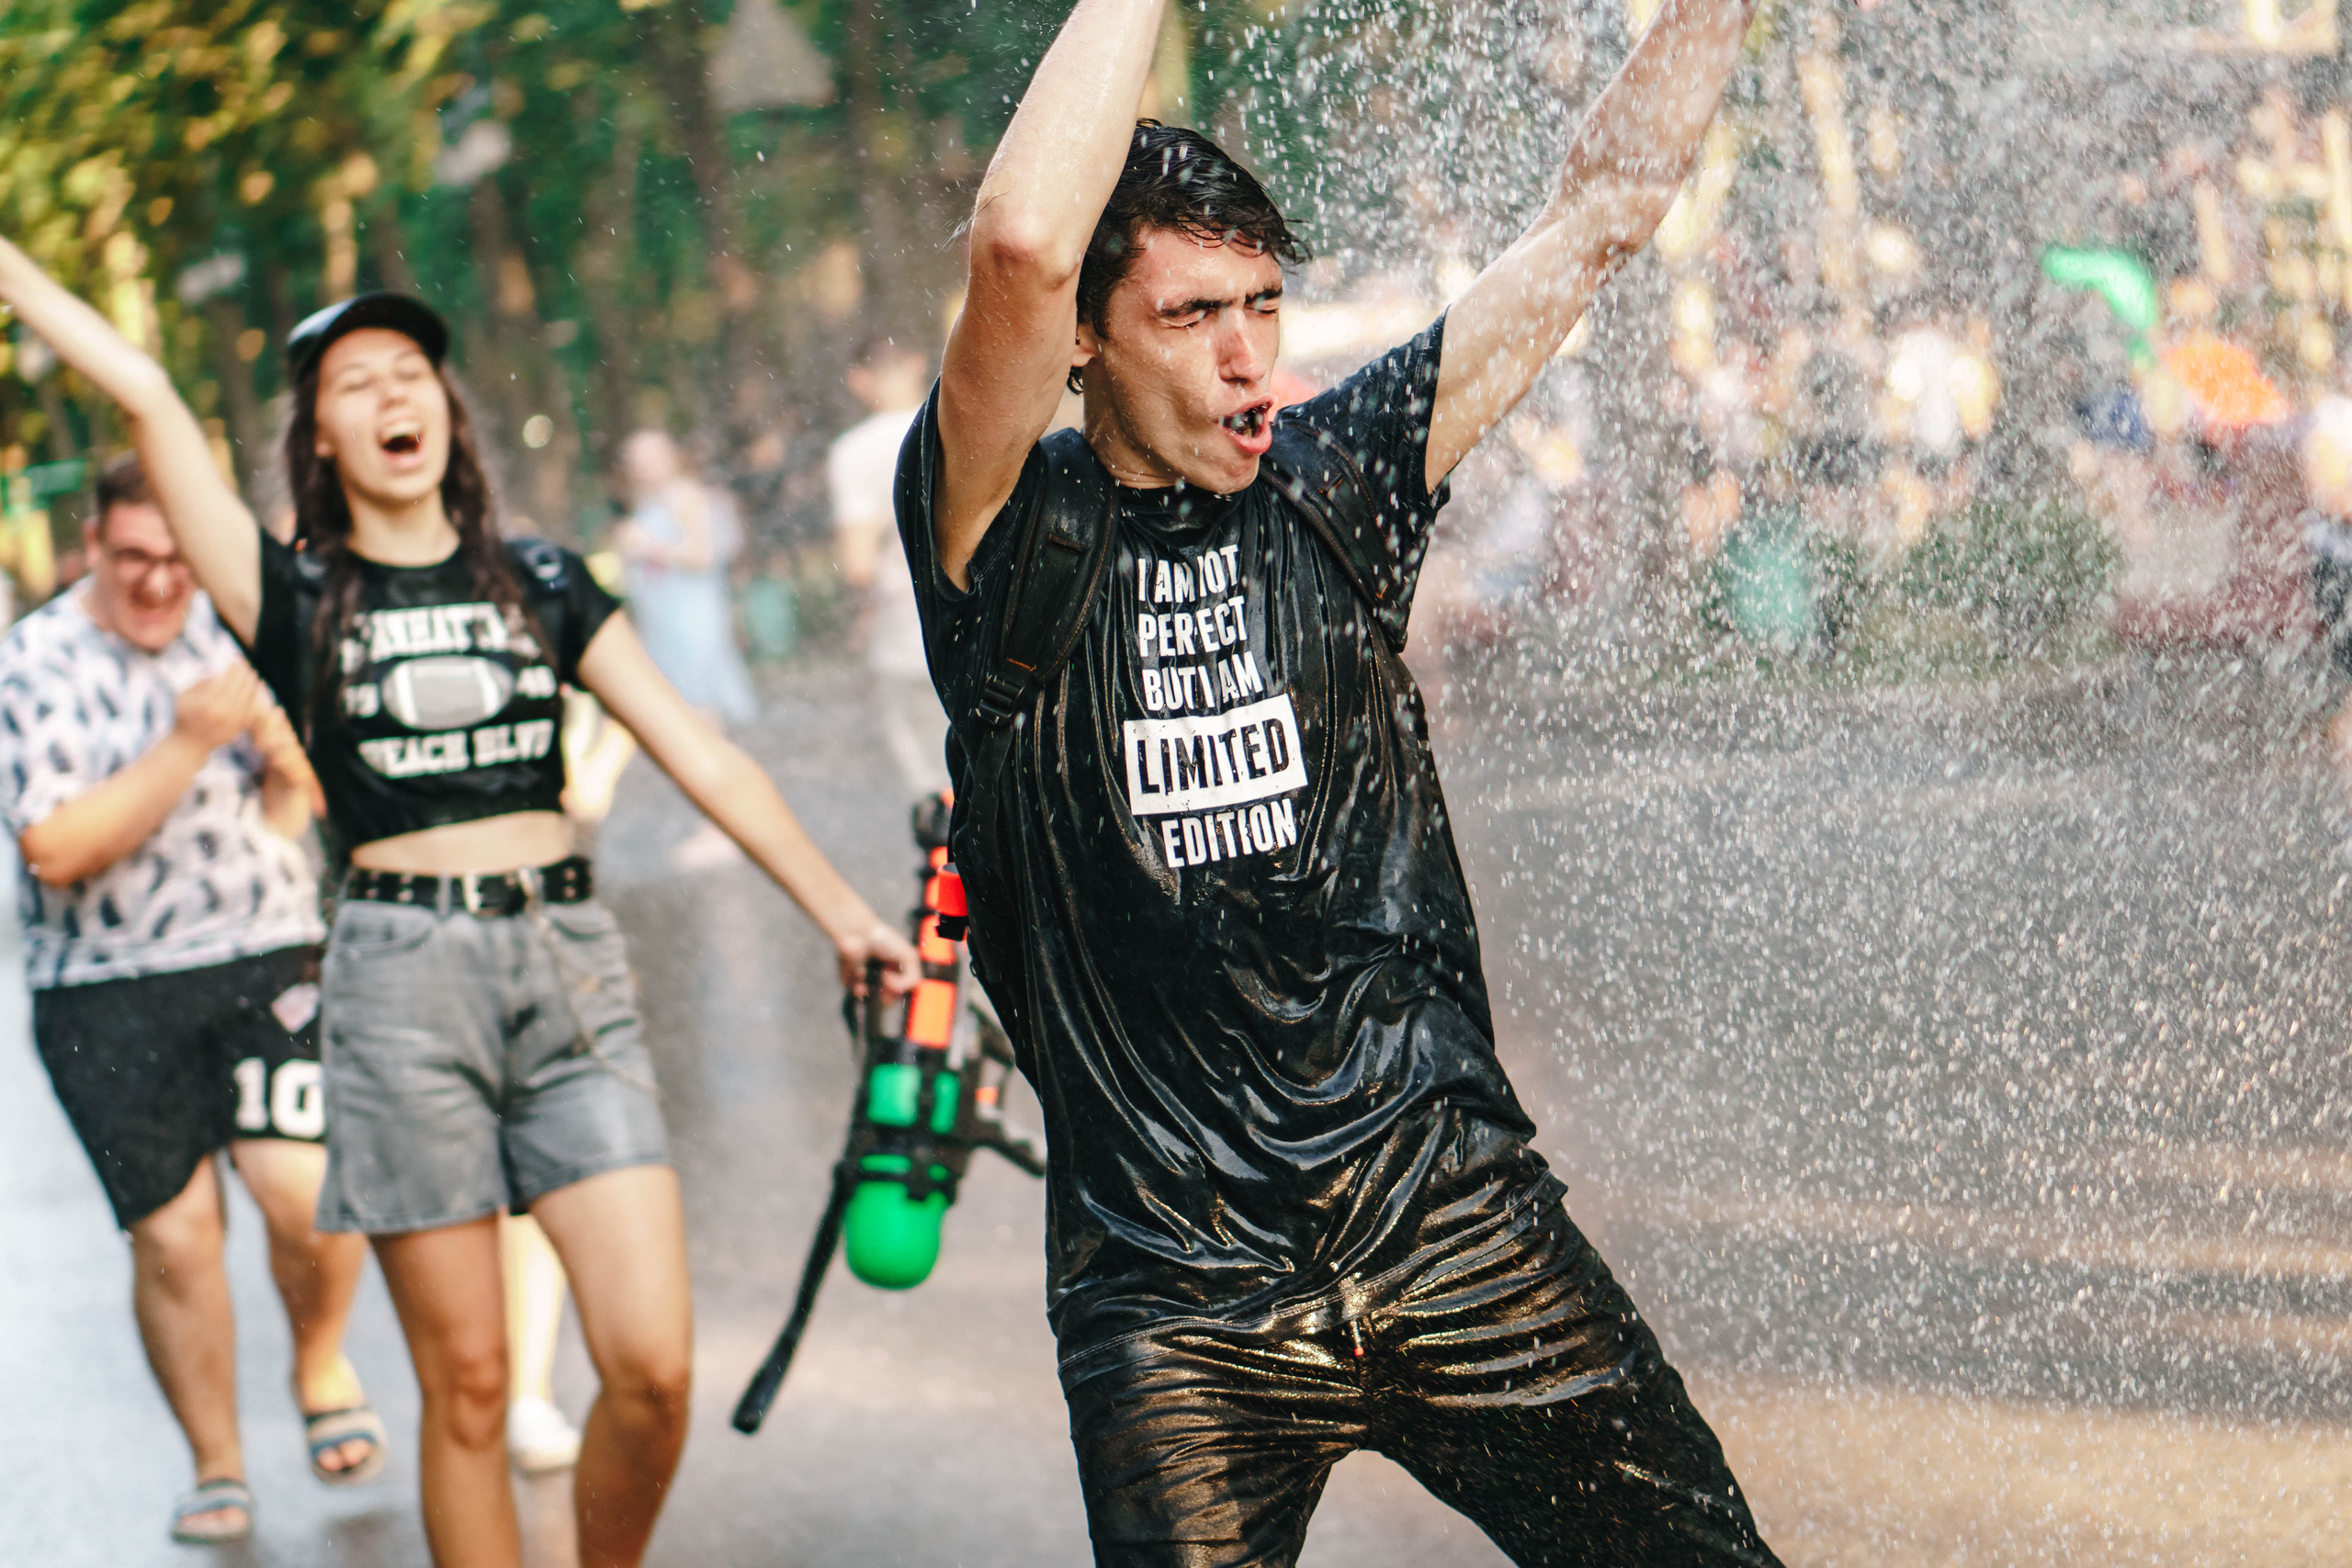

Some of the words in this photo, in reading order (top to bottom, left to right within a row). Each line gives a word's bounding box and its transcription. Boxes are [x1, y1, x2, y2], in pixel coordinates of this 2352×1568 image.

[1137, 558, 1148, 602] I
[1154, 559, 1196, 604] AM
[1138, 595, 1248, 658] PERECT
[1141, 665, 1196, 712] BUT
[1197, 665, 1216, 708] I
[1217, 650, 1264, 703] AM
[1136, 717, 1291, 795] LIMITED
[1160, 798, 1297, 869] EDITION
[233, 1057, 325, 1138] 10
